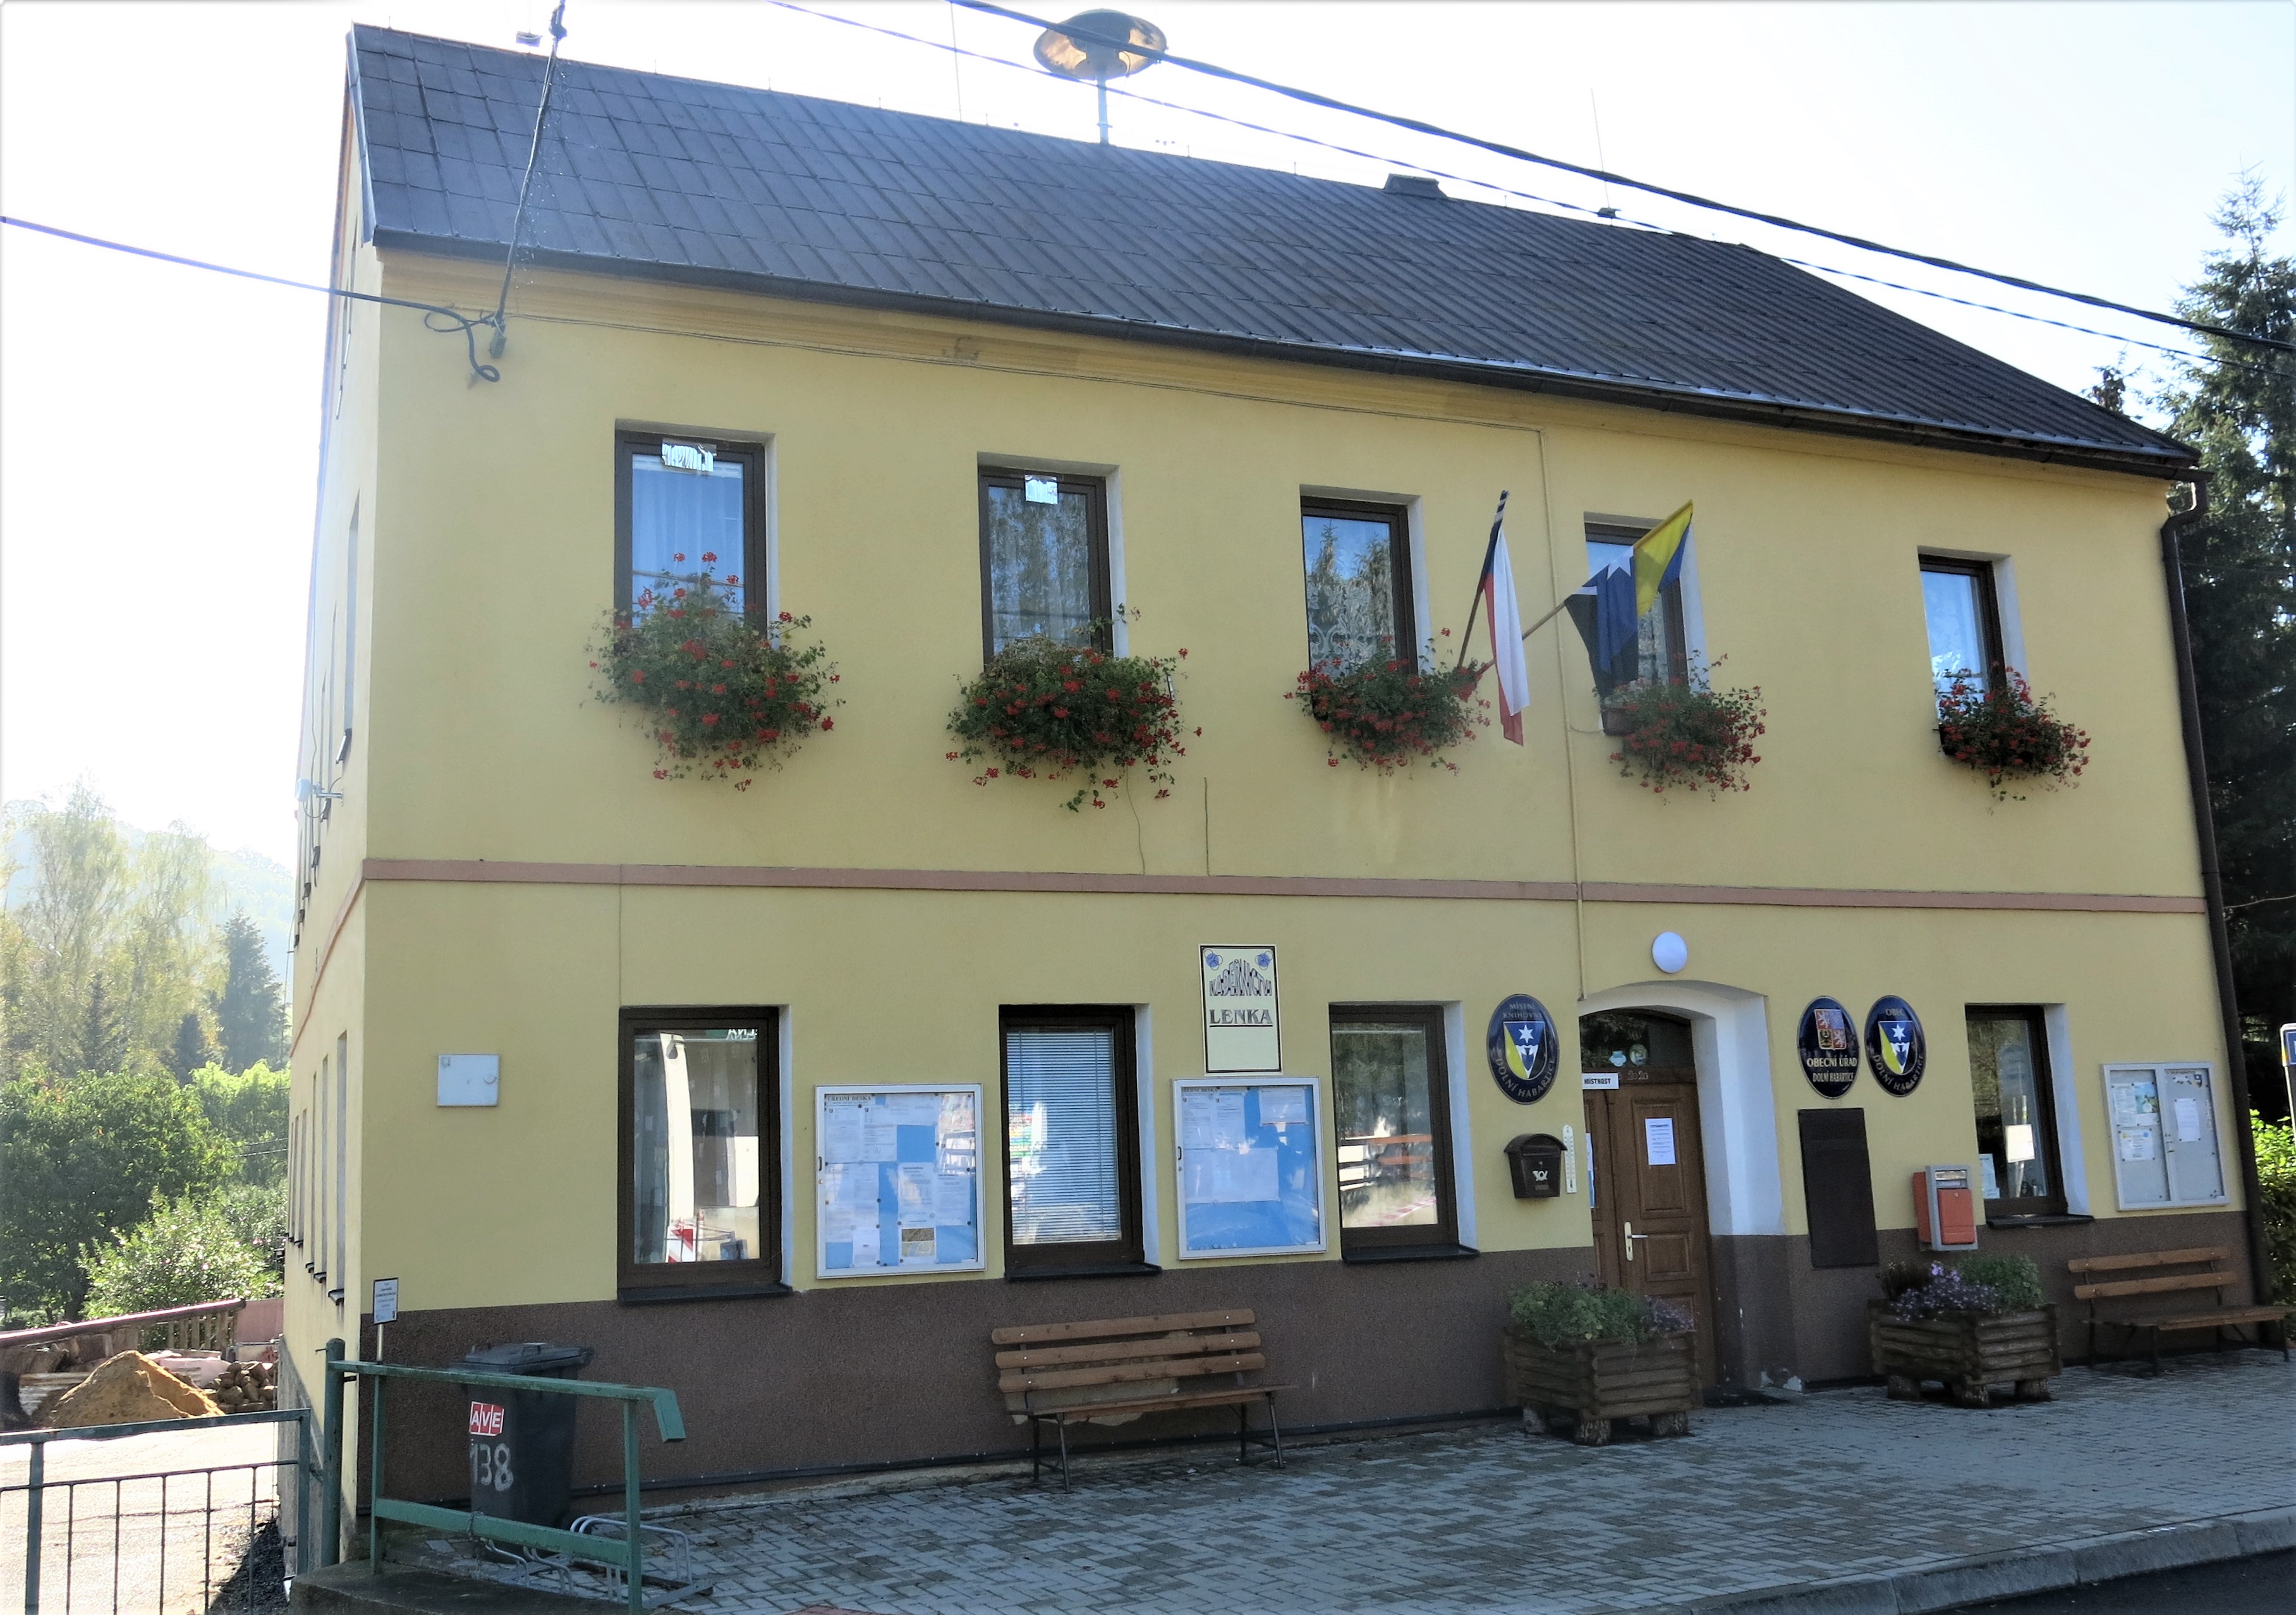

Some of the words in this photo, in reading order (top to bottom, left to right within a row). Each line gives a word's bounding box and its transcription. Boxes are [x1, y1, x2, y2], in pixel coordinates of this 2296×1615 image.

[1509, 1001, 1534, 1010] MÍSTNÍ
[1210, 1009, 1273, 1024] LENKA
[1807, 1055, 1837, 1067] OBECNÍ
[1839, 1055, 1857, 1066] ÚŘAD
[1496, 1059, 1519, 1092] DOLNÍ
[1518, 1057, 1555, 1098] HABARTICE
[1813, 1070, 1829, 1082] DOLNÍ
[1873, 1055, 1895, 1085] DOLNÍ
[471, 1410, 502, 1428] AVE
[470, 1443, 514, 1492] 138
